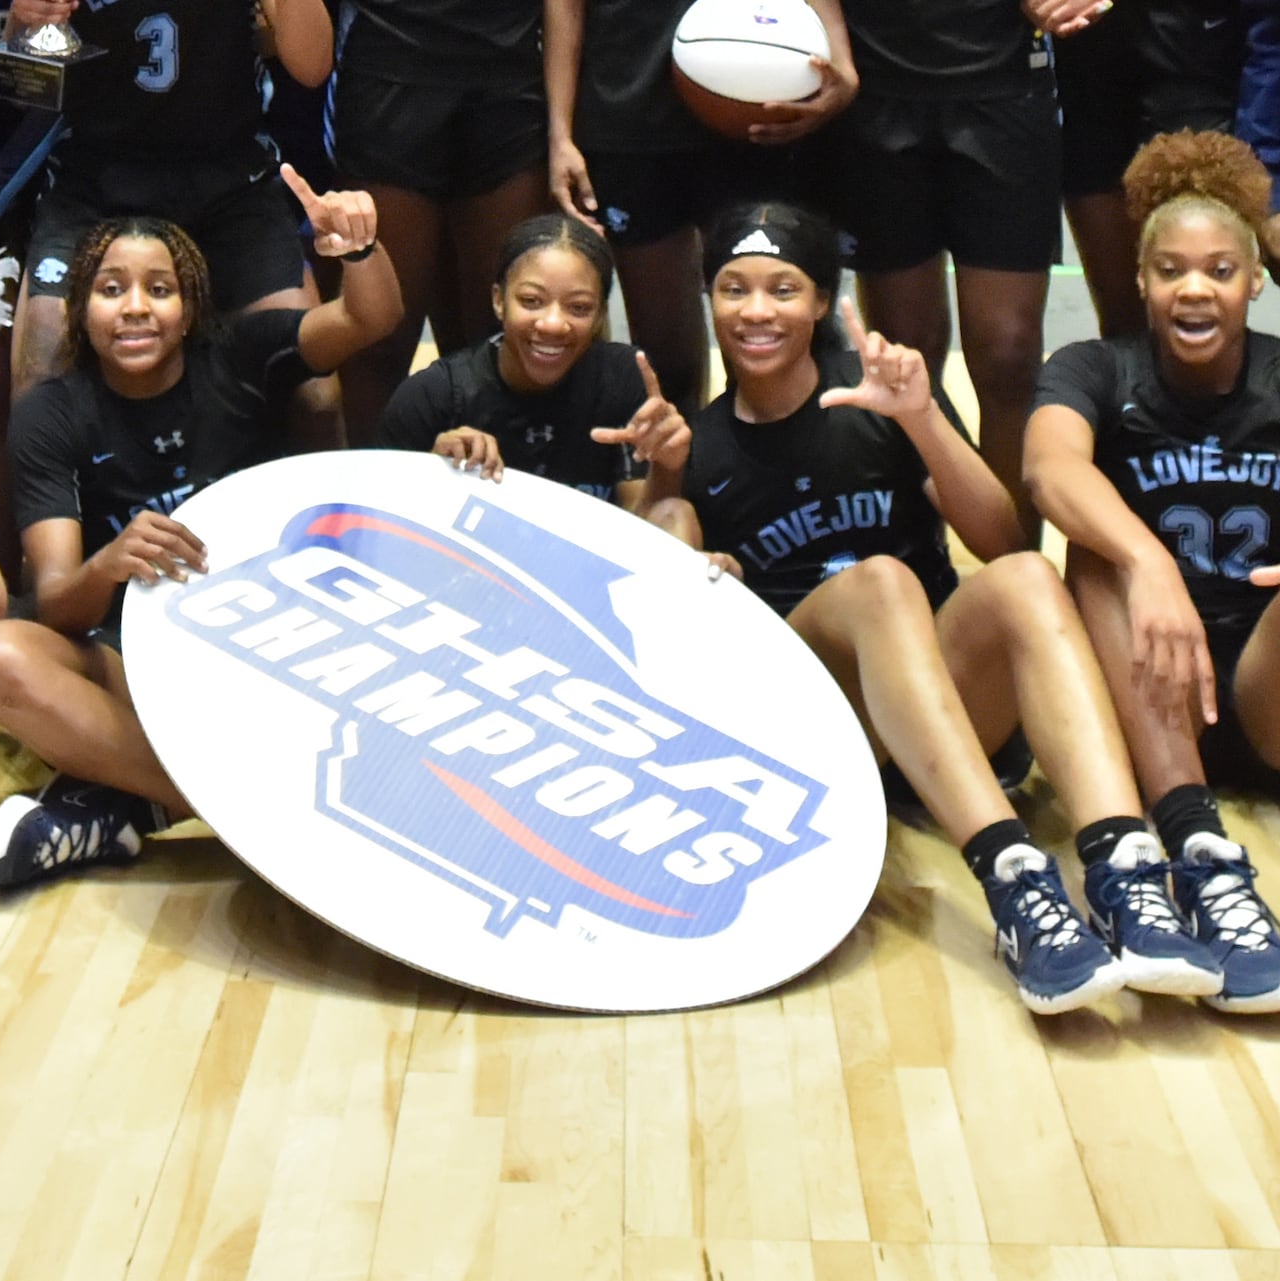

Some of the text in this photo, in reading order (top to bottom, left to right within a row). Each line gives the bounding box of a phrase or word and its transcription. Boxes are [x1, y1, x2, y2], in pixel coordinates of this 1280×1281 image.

[134, 12, 180, 93] 3
[739, 489, 894, 570] LOVEJOY
[1159, 504, 1271, 581] 32
[178, 579, 764, 886] CHAMPIONS
[269, 546, 809, 845] GHSA
